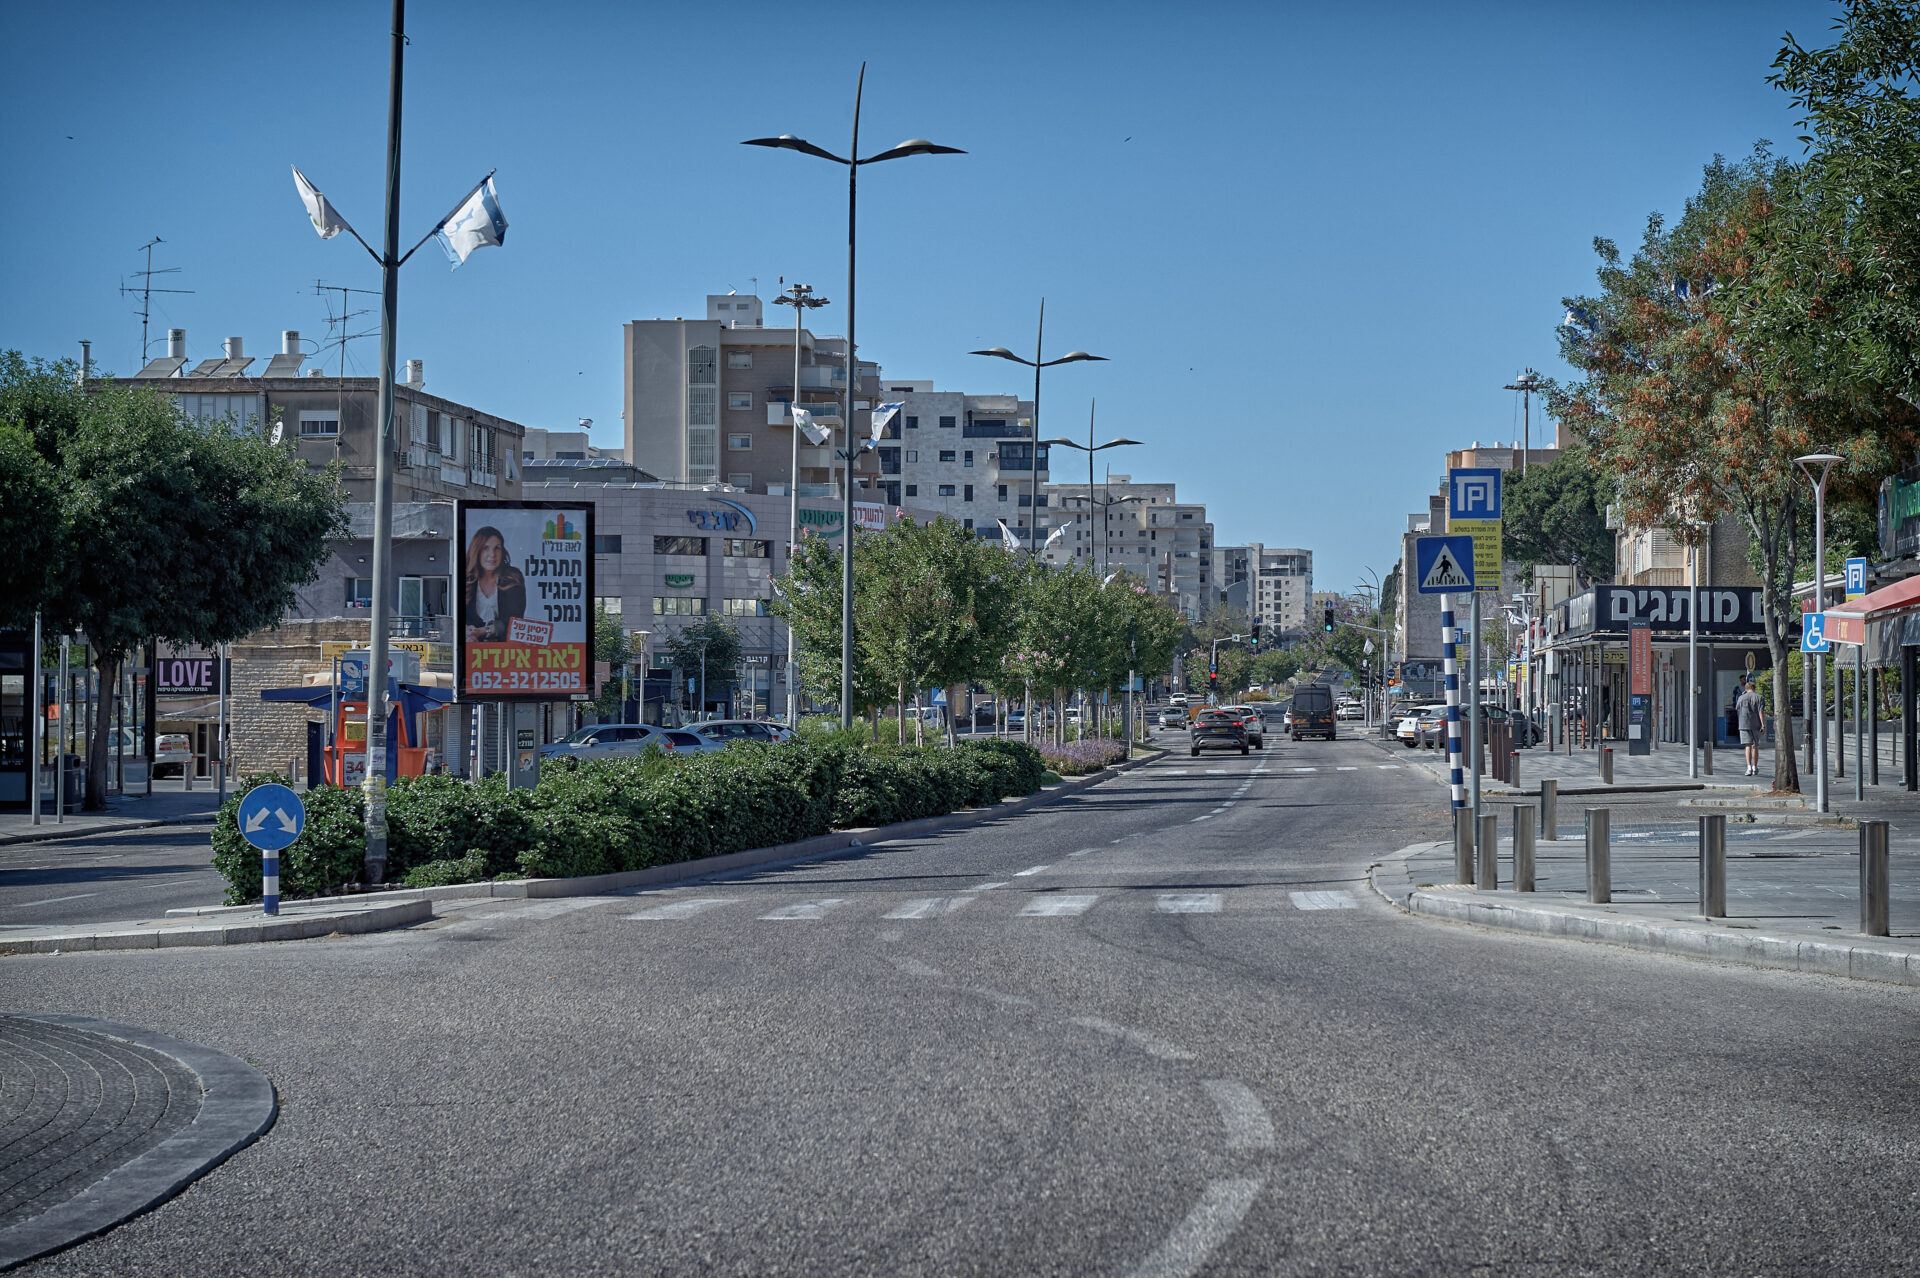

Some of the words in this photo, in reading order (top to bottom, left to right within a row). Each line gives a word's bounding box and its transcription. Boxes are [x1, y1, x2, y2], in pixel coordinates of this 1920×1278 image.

[563, 541, 582, 553] לאה
[525, 555, 582, 577] תתרגלו
[538, 578, 582, 600] להגיד
[544, 604, 582, 623] נמכר
[1611, 589, 1740, 624] מותגים
[513, 621, 526, 631] של
[527, 625, 549, 635] ניסיון
[515, 632, 526, 640] 17
[526, 634, 544, 643] שנה
[472, 648, 531, 669] אינדיג
[538, 644, 581, 668] לאה
[158, 661, 213, 687] LOVE
[471, 672, 581, 689] 052-3212505
[345, 761, 366, 774] 34
